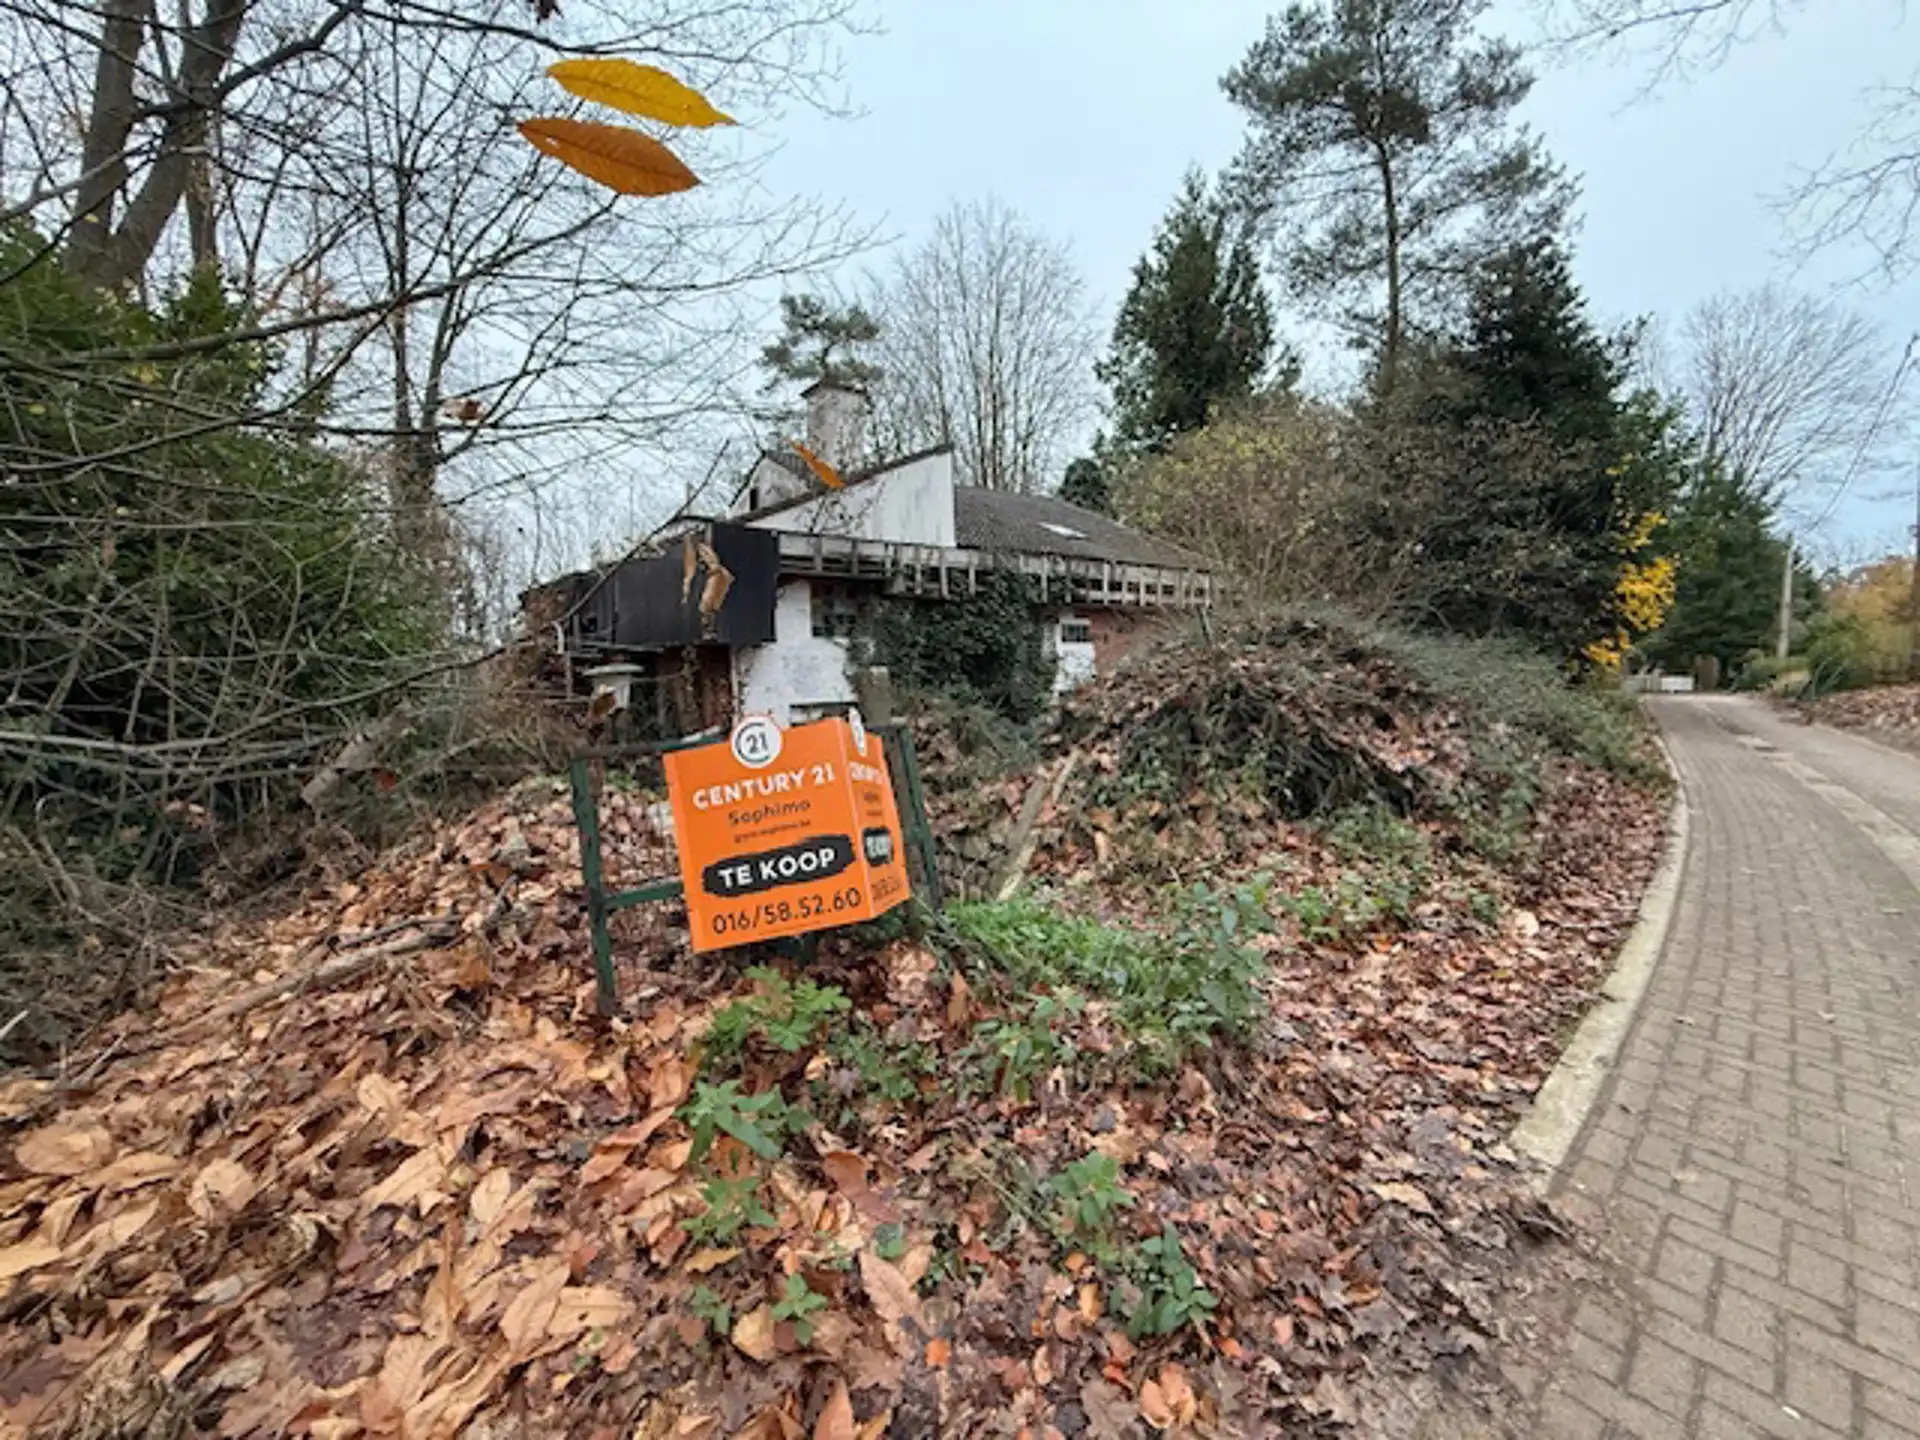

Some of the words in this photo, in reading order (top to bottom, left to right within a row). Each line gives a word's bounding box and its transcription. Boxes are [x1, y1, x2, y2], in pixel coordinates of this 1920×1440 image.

[692, 770, 805, 809] CENTURY
[811, 763, 835, 784] 21
[718, 865, 753, 888] TE
[758, 848, 835, 879] KOOP
[712, 887, 861, 934] 016/58.52.60
